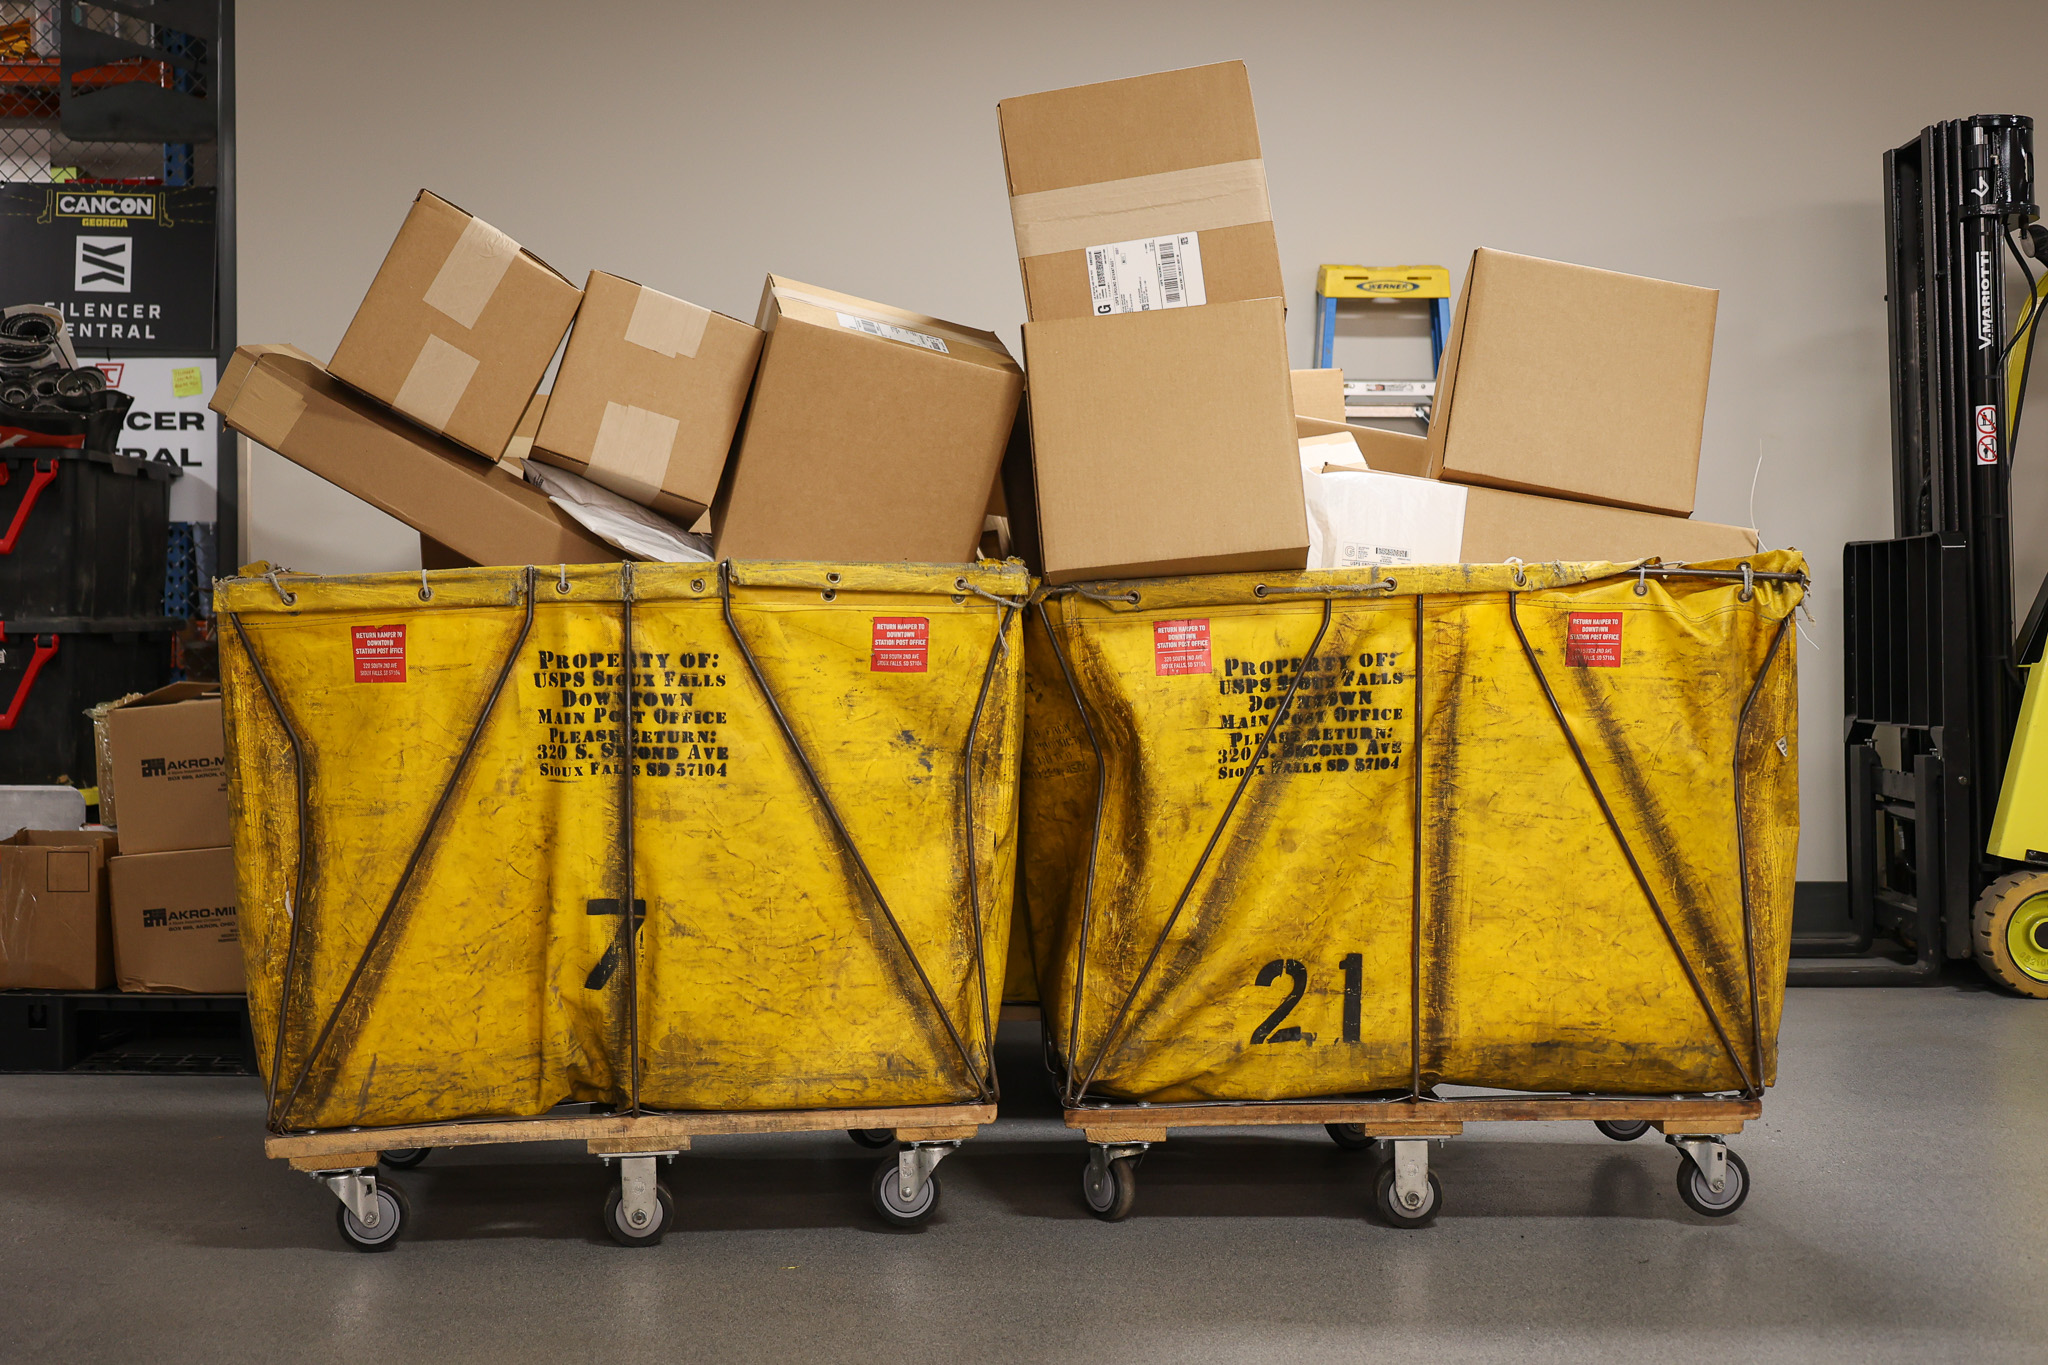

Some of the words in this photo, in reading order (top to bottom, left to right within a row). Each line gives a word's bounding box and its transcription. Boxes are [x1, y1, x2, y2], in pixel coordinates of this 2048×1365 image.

[59, 196, 152, 215] CANCON
[82, 218, 128, 228] GEORGIA
[1097, 304, 1111, 314] G
[1976, 250, 1993, 351] V.MARIOTTI
[65, 323, 156, 339] ENTRAL
[538, 650, 670, 670] PROPERTY
[680, 652, 719, 668] OF:
[1225, 655, 1351, 677] PROPERTY
[1359, 652, 1396, 668] OF:
[533, 671, 585, 688] USPS
[592, 670, 656, 687] SIOUX
[664, 671, 726, 687] FALLS
[1219, 678, 1271, 695] USPS
[1341, 671, 1404, 687] FALLS
[562, 689, 694, 708] DOWNTOWN
[1249, 691, 1373, 713] DOWNTOWN
[538, 708, 585, 724] MAIN
[594, 707, 646, 724] POT
[653, 708, 727, 724] OFFICE
[1220, 714, 1269, 729] MAIN
[1277, 710, 1327, 726] POST
[1334, 707, 1403, 722] OFFICE
[549, 727, 621, 744] PLEASE
[1230, 730, 1301, 748] PLEASE
[1307, 727, 1393, 741] RETURN:
[537, 744, 567, 760] 320
[575, 743, 593, 760] S.
[688, 744, 729, 760] AVE
[1218, 747, 1251, 764] 320
[1282, 743, 1358, 758] SECOND
[1366, 740, 1402, 755] AVE
[167, 756, 225, 770] AKRO-M
[540, 763, 583, 777] SIOUX
[646, 762, 670, 777] SD
[675, 762, 727, 777] 57104
[1218, 765, 1265, 780] SIOX
[1271, 760, 1322, 775] FALLS
[1326, 758, 1349, 772] SD
[1355, 756, 1400, 772] 57104
[584, 898, 646, 990] 7
[1249, 952, 1362, 1045] 21
